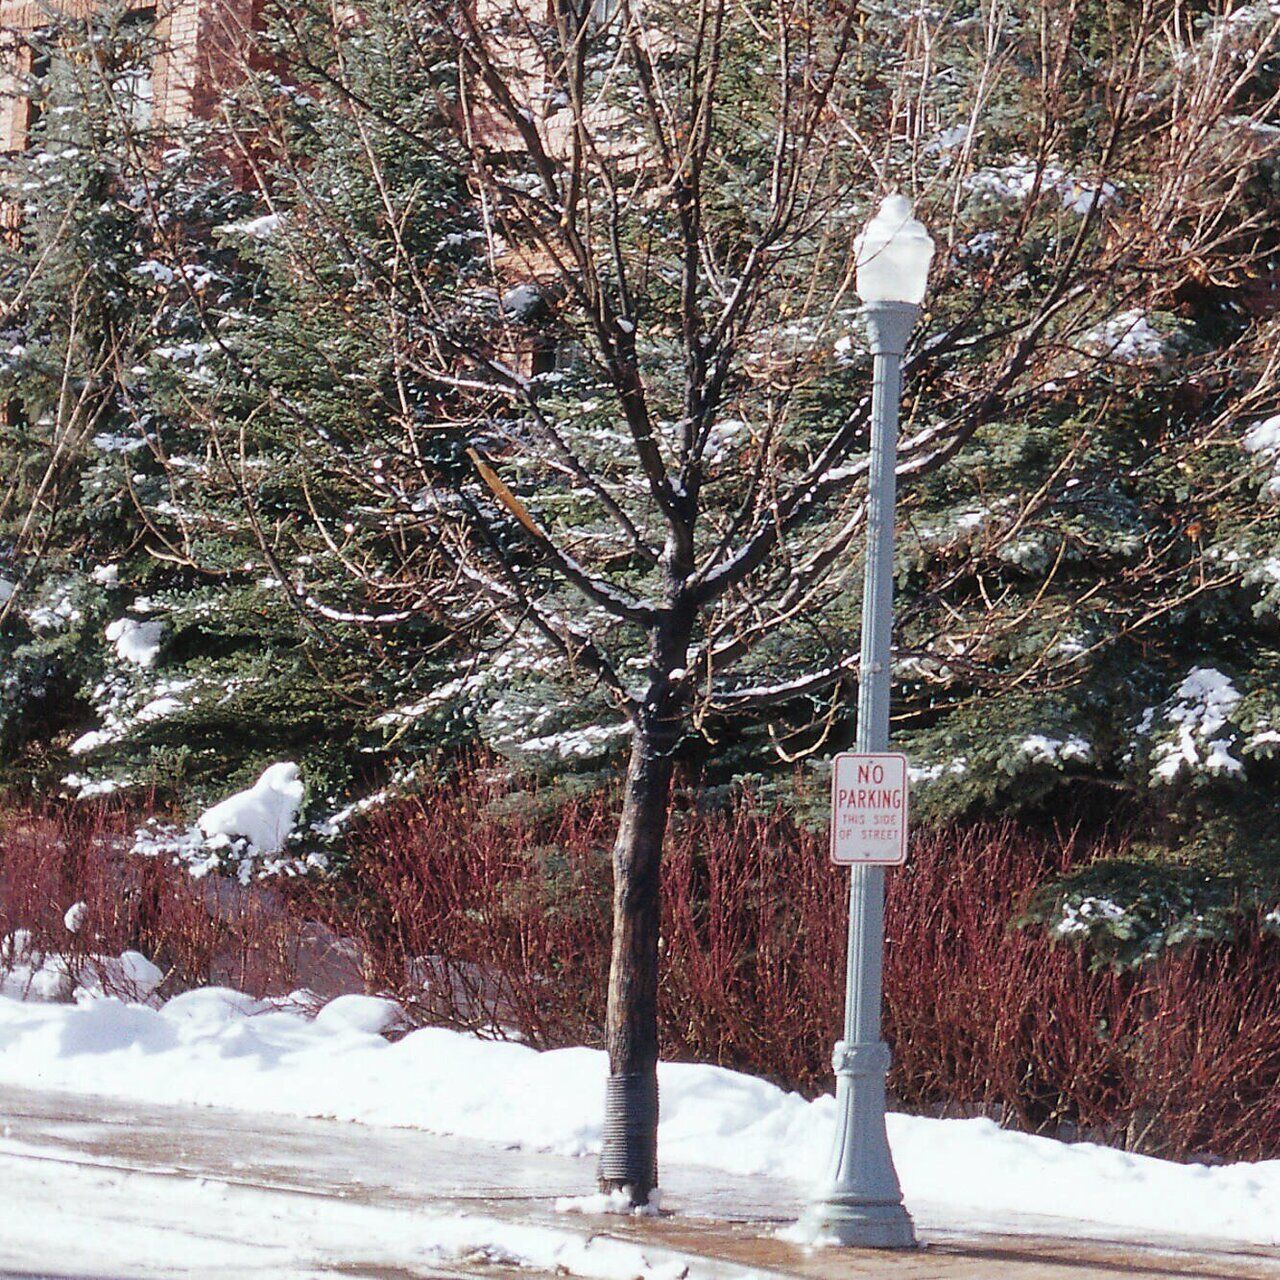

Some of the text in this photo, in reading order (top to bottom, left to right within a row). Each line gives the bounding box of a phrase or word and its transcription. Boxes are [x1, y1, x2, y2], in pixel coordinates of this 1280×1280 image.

[857, 765, 884, 784] NO
[838, 789, 901, 809] PARKING
[842, 815, 897, 825] THIS SIDE
[839, 830, 898, 840] OF STREET
